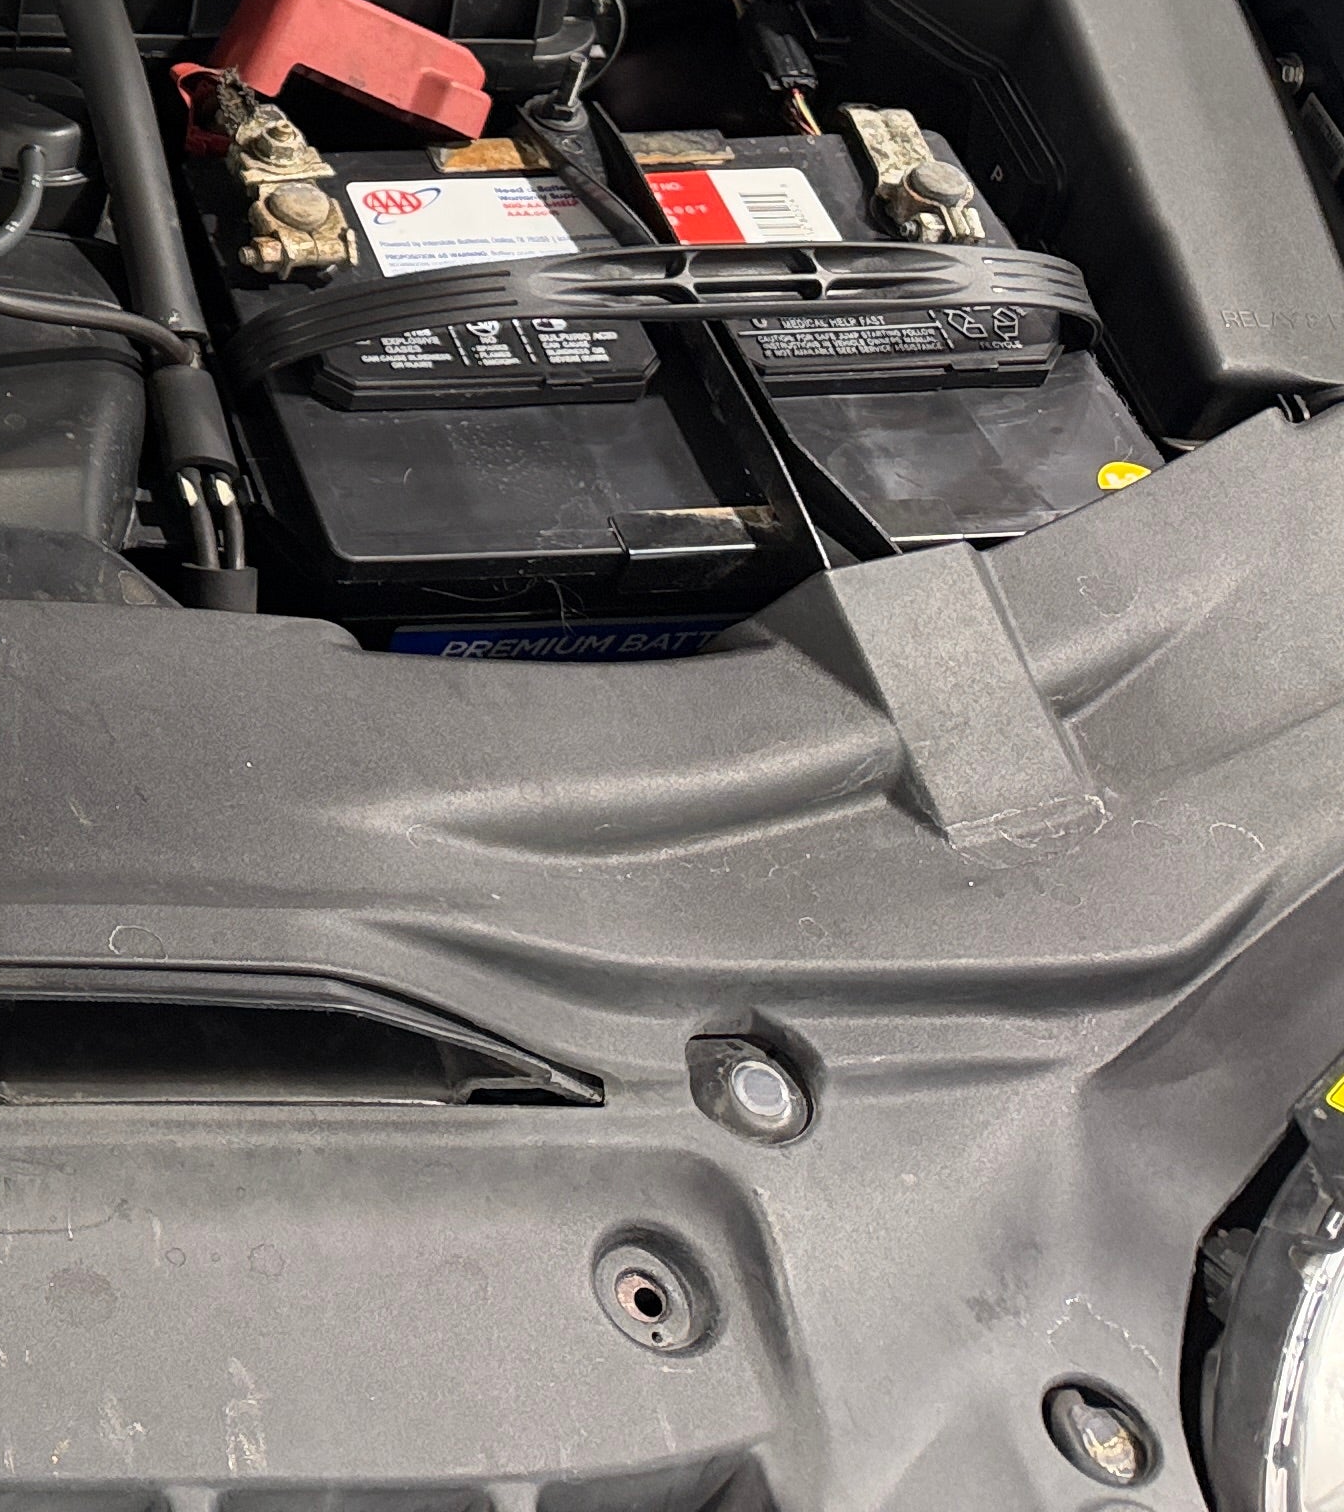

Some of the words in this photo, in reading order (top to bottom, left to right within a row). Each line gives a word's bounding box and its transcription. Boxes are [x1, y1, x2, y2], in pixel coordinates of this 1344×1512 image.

[367, 191, 421, 214] AAA
[781, 318, 828, 328] MEDICAL
[829, 317, 856, 327] HELP
[858, 316, 885, 326] FAST
[440, 635, 616, 658] PREMIUM
[617, 631, 722, 653] BATT
